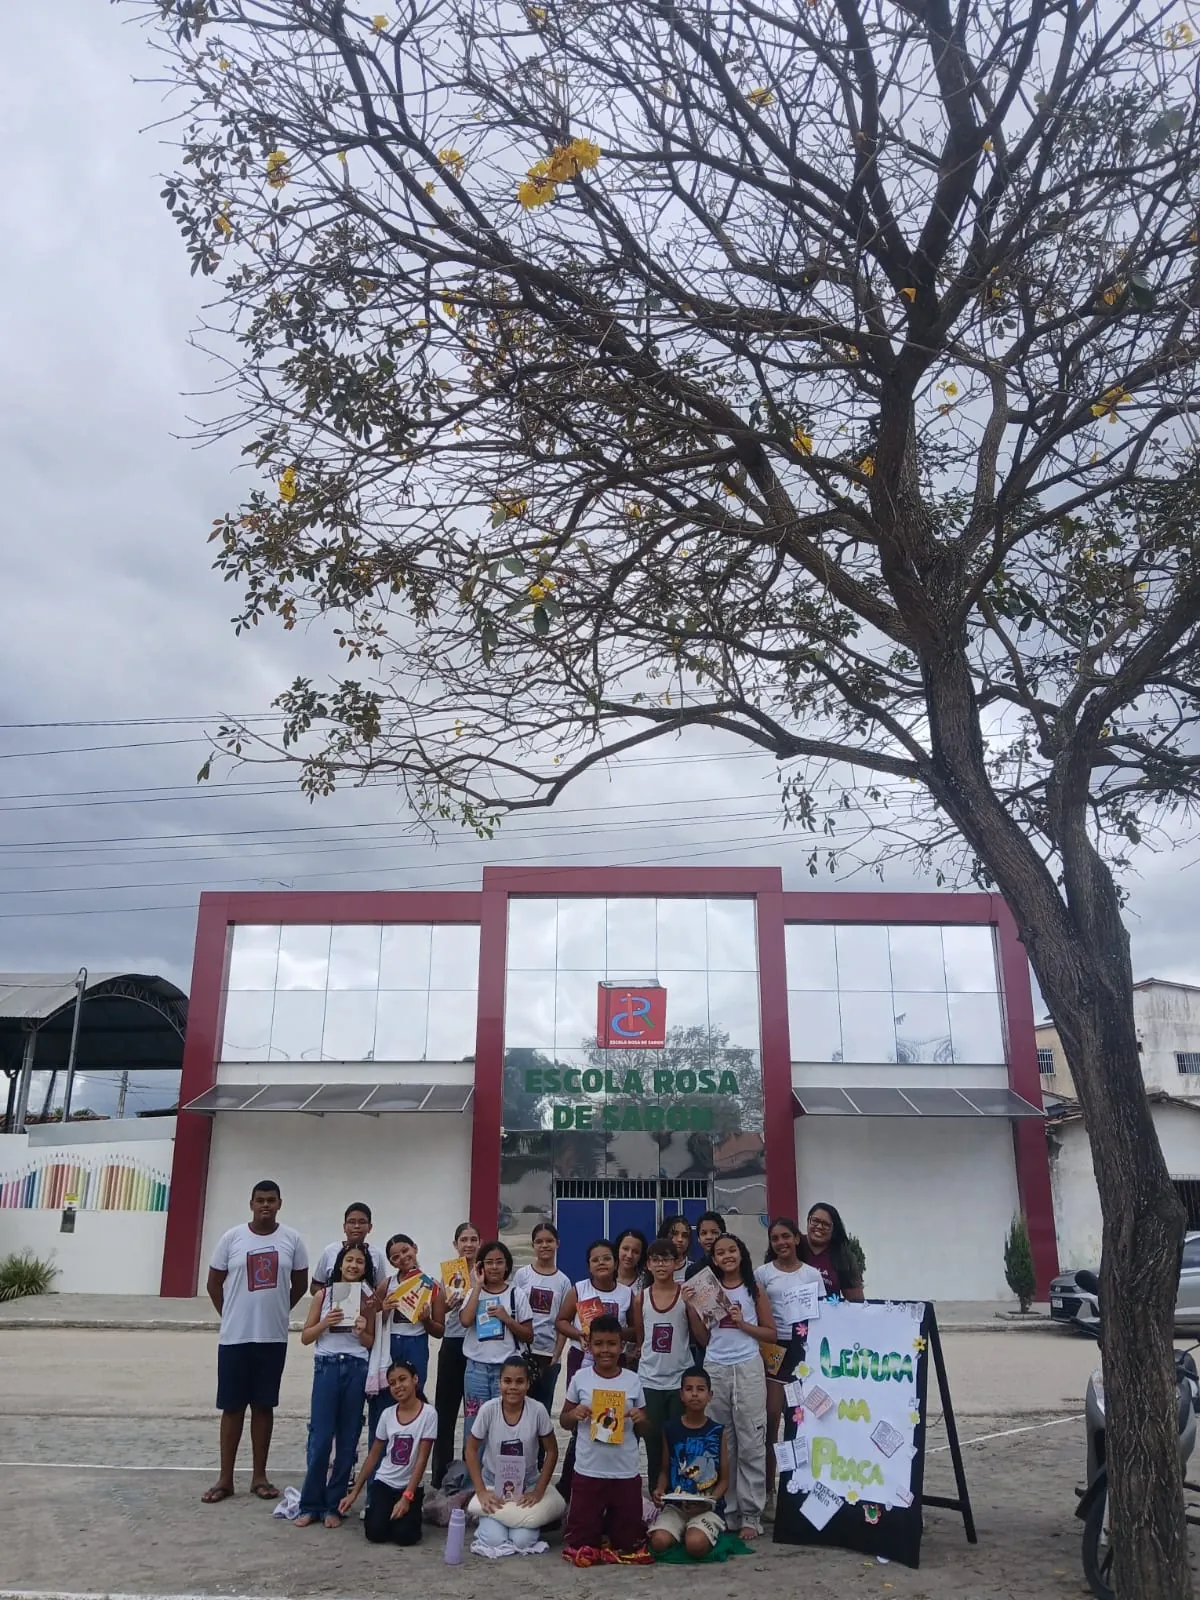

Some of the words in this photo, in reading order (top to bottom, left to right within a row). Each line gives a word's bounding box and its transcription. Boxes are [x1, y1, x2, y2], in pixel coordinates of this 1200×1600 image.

[525, 1068, 644, 1094] ESCOLA
[653, 1069, 740, 1095] ROSA
[553, 1105, 593, 1130] DE
[602, 1104, 714, 1132] SARON
[837, 1398, 872, 1424] NA
[811, 1435, 885, 1490] PRAÇA
